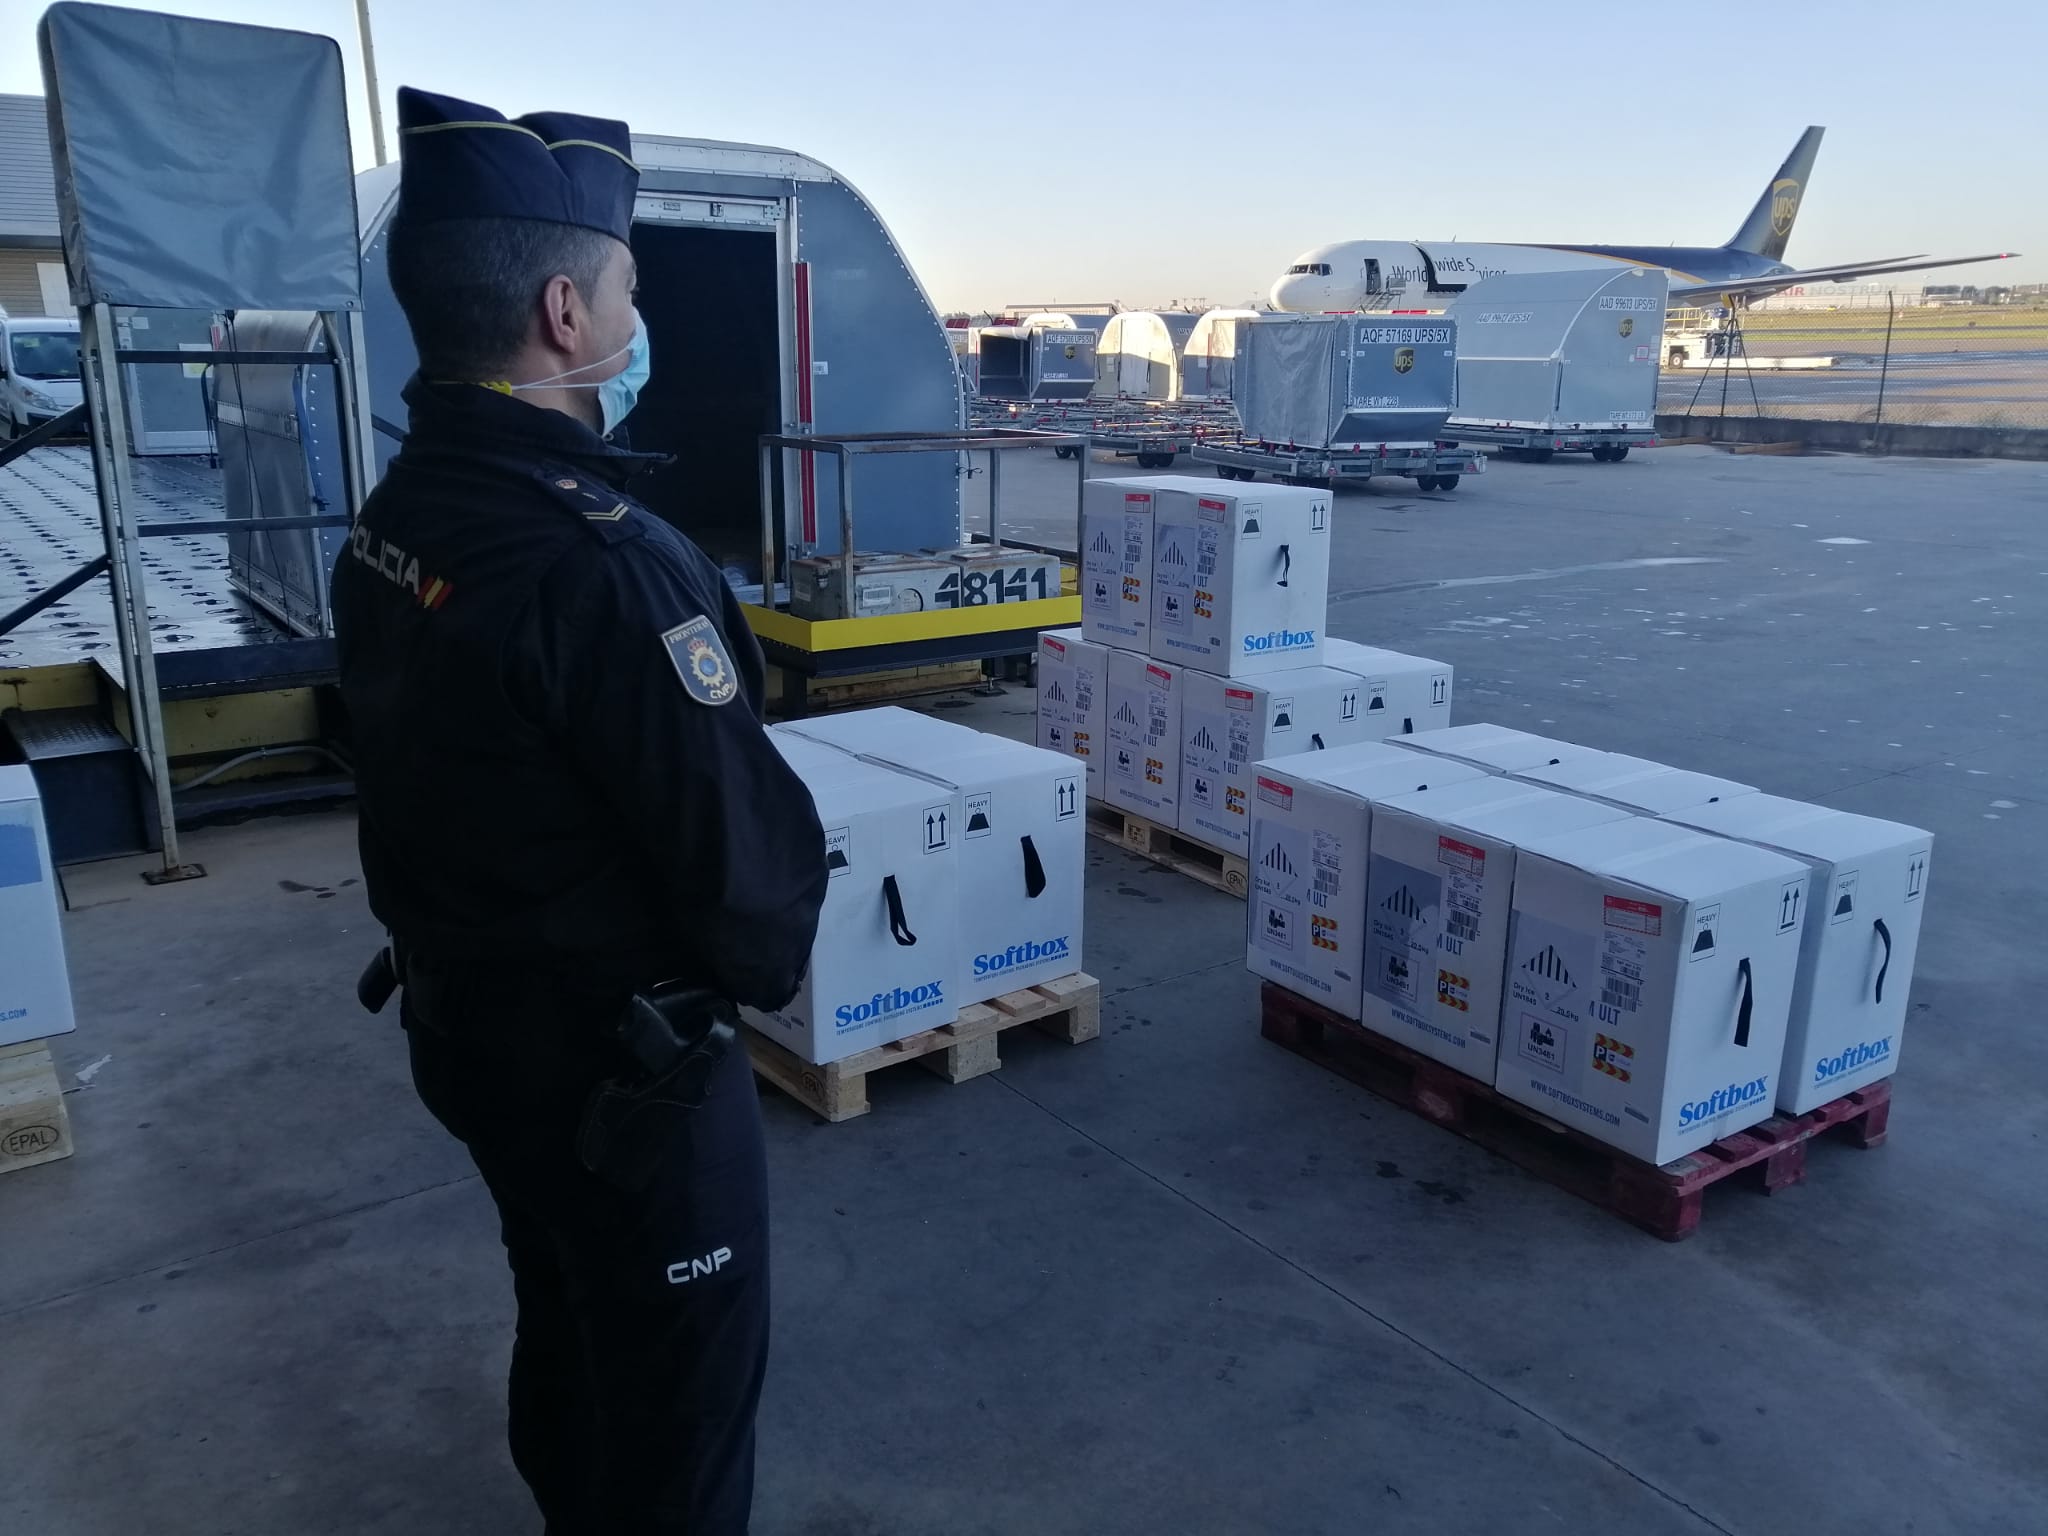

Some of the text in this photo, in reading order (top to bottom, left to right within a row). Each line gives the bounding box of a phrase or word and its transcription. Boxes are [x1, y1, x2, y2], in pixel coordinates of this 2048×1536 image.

[1774, 195, 1796, 225] ups
[1362, 329, 1449, 343] AQF 57169 UPS/5X
[1395, 356, 1413, 371] ups
[934, 567, 1047, 609] 48141
[1243, 629, 1315, 652] Softbox
[709, 683, 731, 699] CNP
[1275, 702, 1291, 711] HEAVY
[1227, 763, 1239, 776] ULT
[967, 800, 988, 809] HEAVY
[1313, 890, 1328, 908] ULT
[1696, 912, 1717, 924] HEAVY
[973, 935, 1070, 976] Softbox
[1446, 935, 1464, 956] ULT
[1513, 981, 1525, 994] Dry
[835, 980, 943, 1028] Softbox
[1599, 1003, 1621, 1026] ULT
[1814, 1036, 1892, 1082] Softbox
[1530, 1079, 1621, 1127] WWW.SOFTBOXSYSTEMS.COM
[1678, 1075, 1768, 1128] Softbox
[9, 1130, 50, 1152] EPAL
[667, 1246, 732, 1284] CNP
